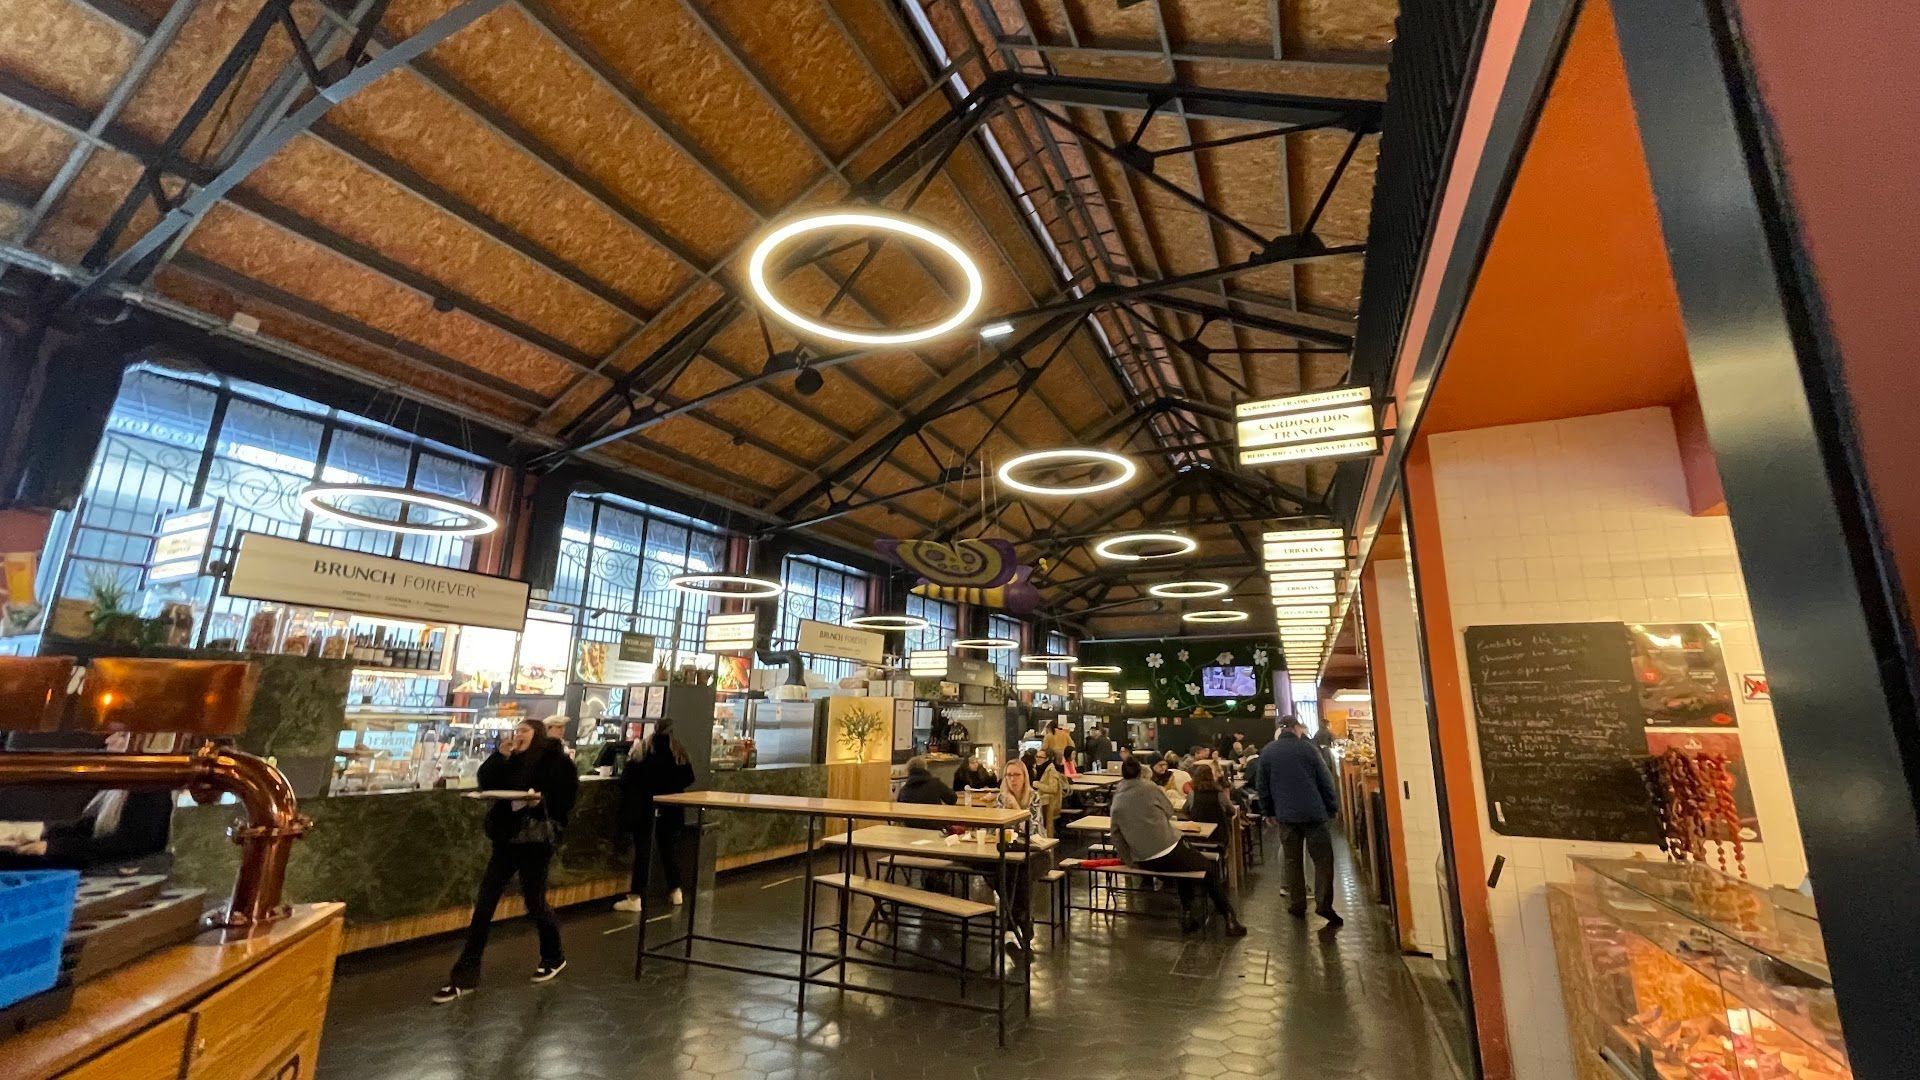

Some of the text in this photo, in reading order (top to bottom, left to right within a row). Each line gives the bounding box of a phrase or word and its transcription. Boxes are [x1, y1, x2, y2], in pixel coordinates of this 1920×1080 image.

[1259, 413, 1350, 432] CARDOSO DOS
[313, 560, 475, 598] BRUNCH FOREVER
